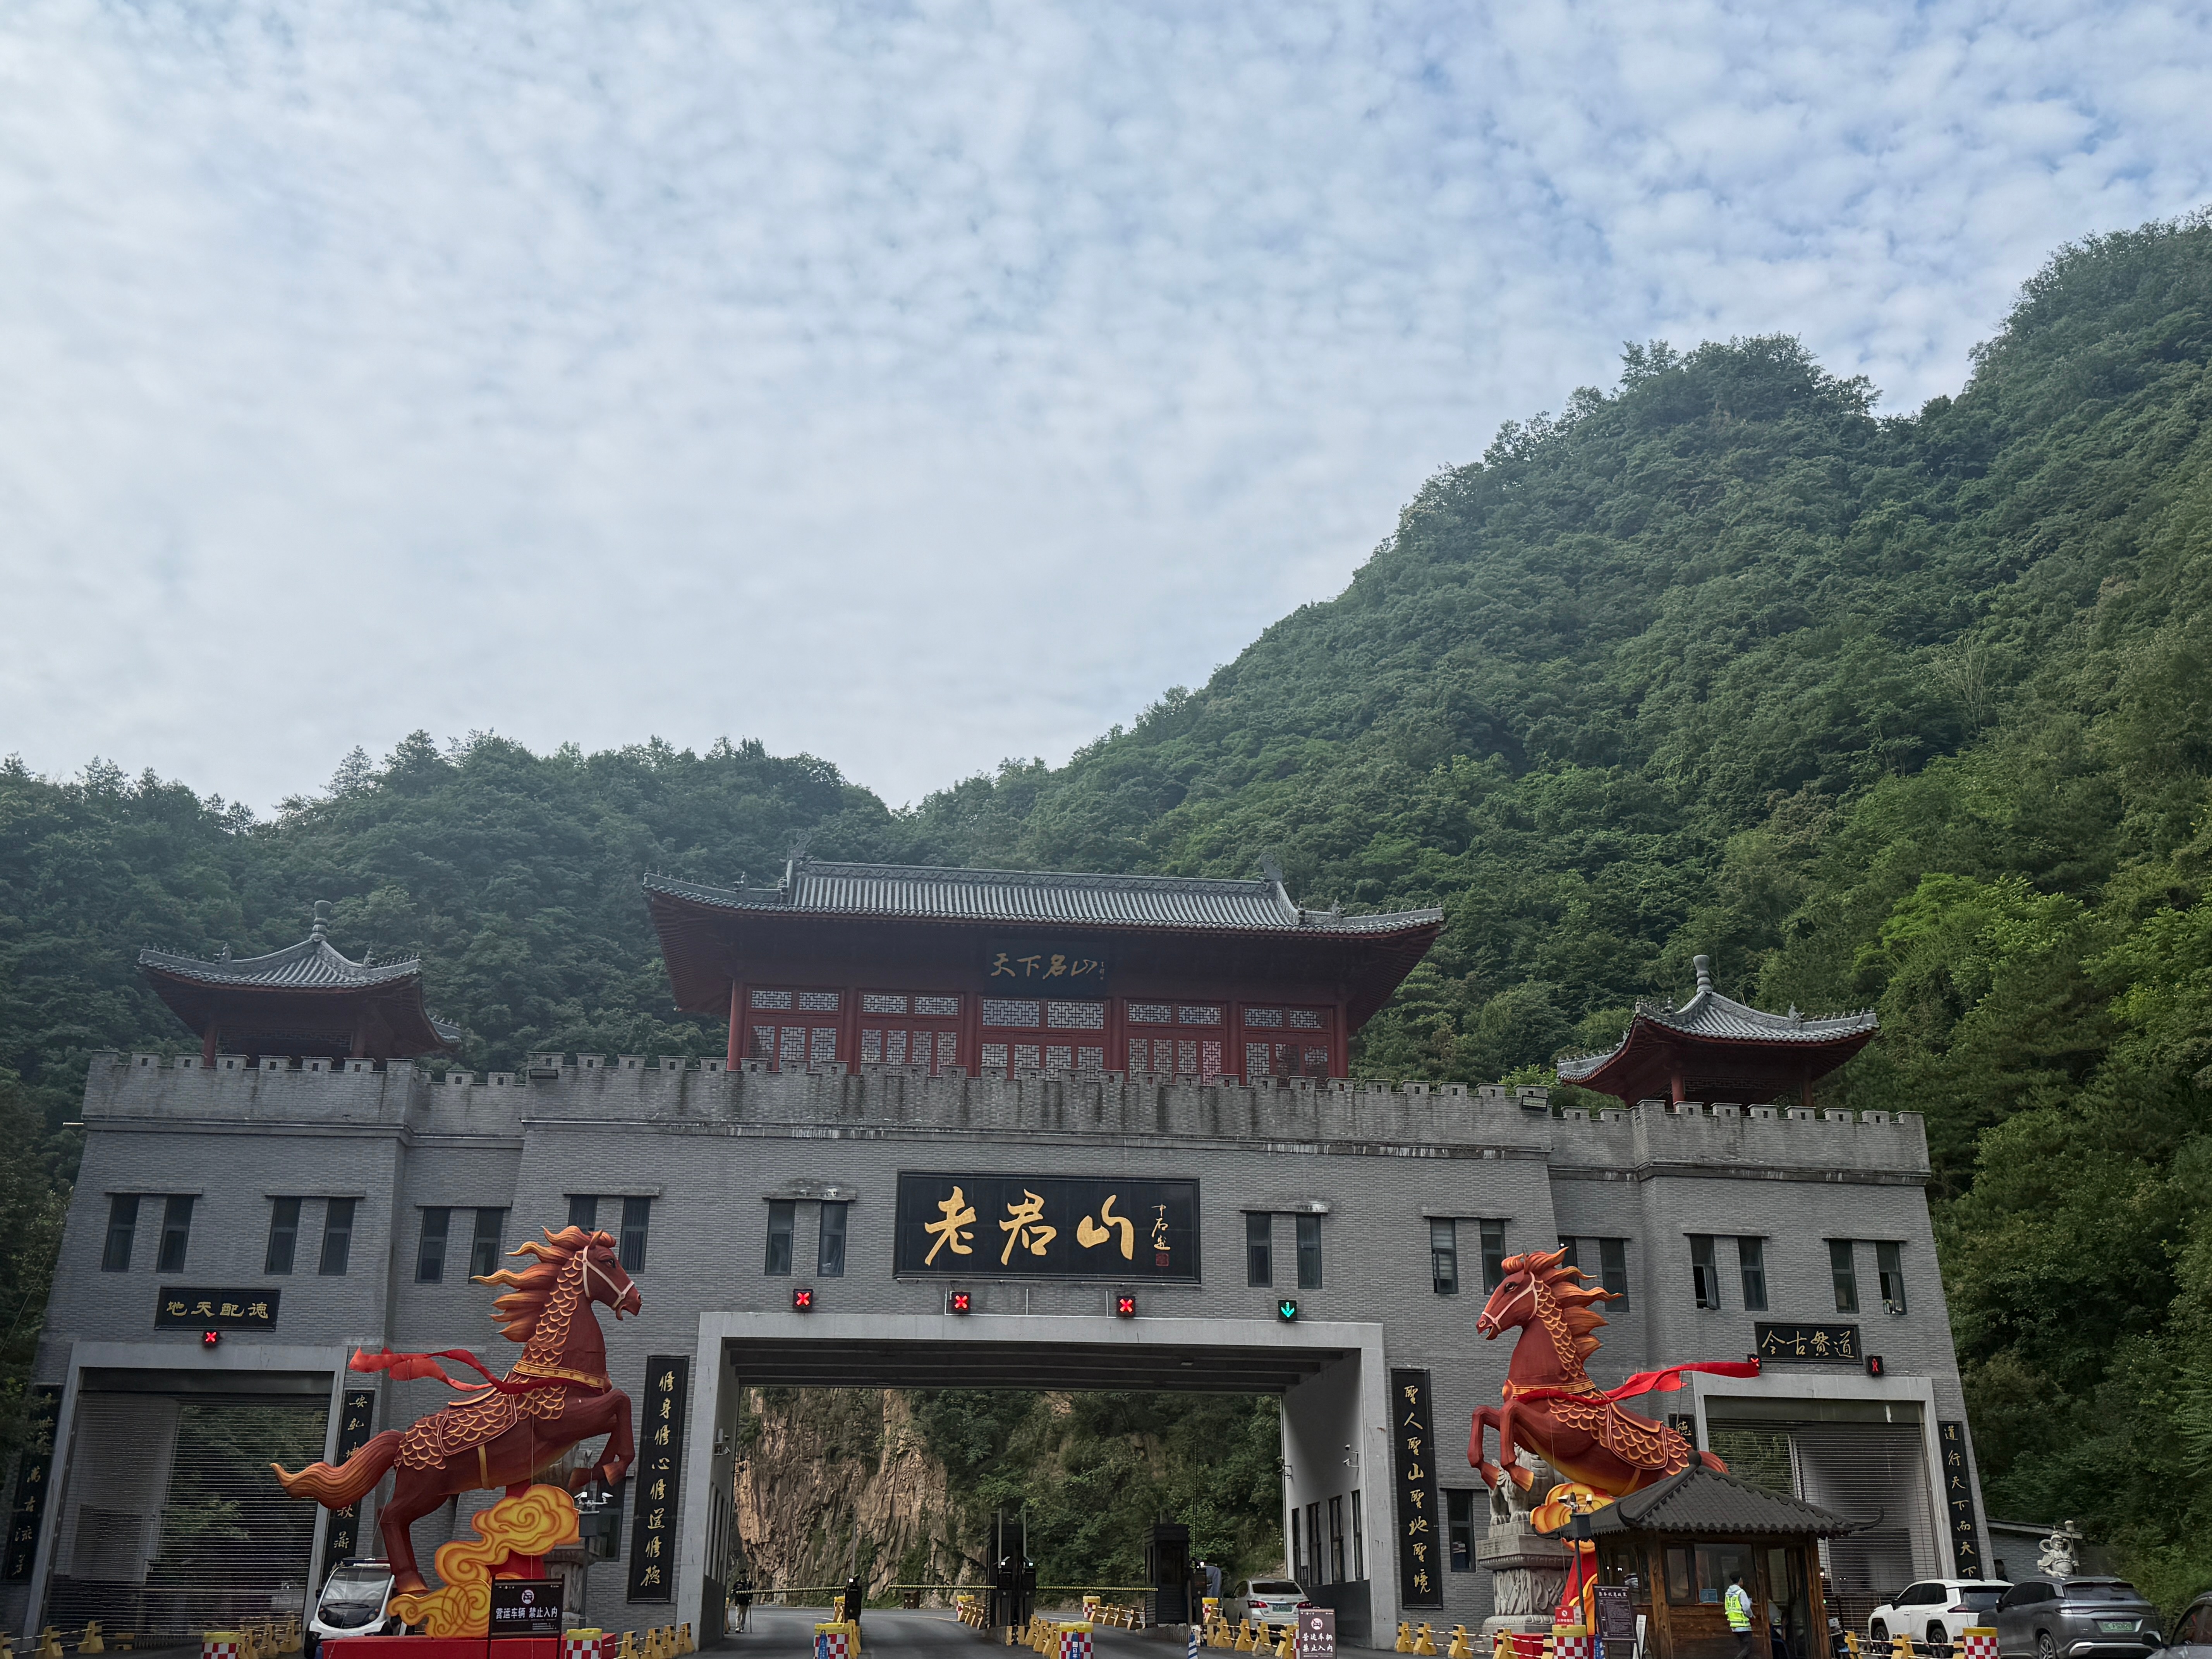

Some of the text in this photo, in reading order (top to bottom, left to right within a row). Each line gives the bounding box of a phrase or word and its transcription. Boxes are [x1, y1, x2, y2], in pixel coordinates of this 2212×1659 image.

[991, 953, 1098, 980] 天下名山
[924, 1186, 1134, 1266] 老君山
[496, 1606, 558, 1619] 营运车辆 禁止入内
